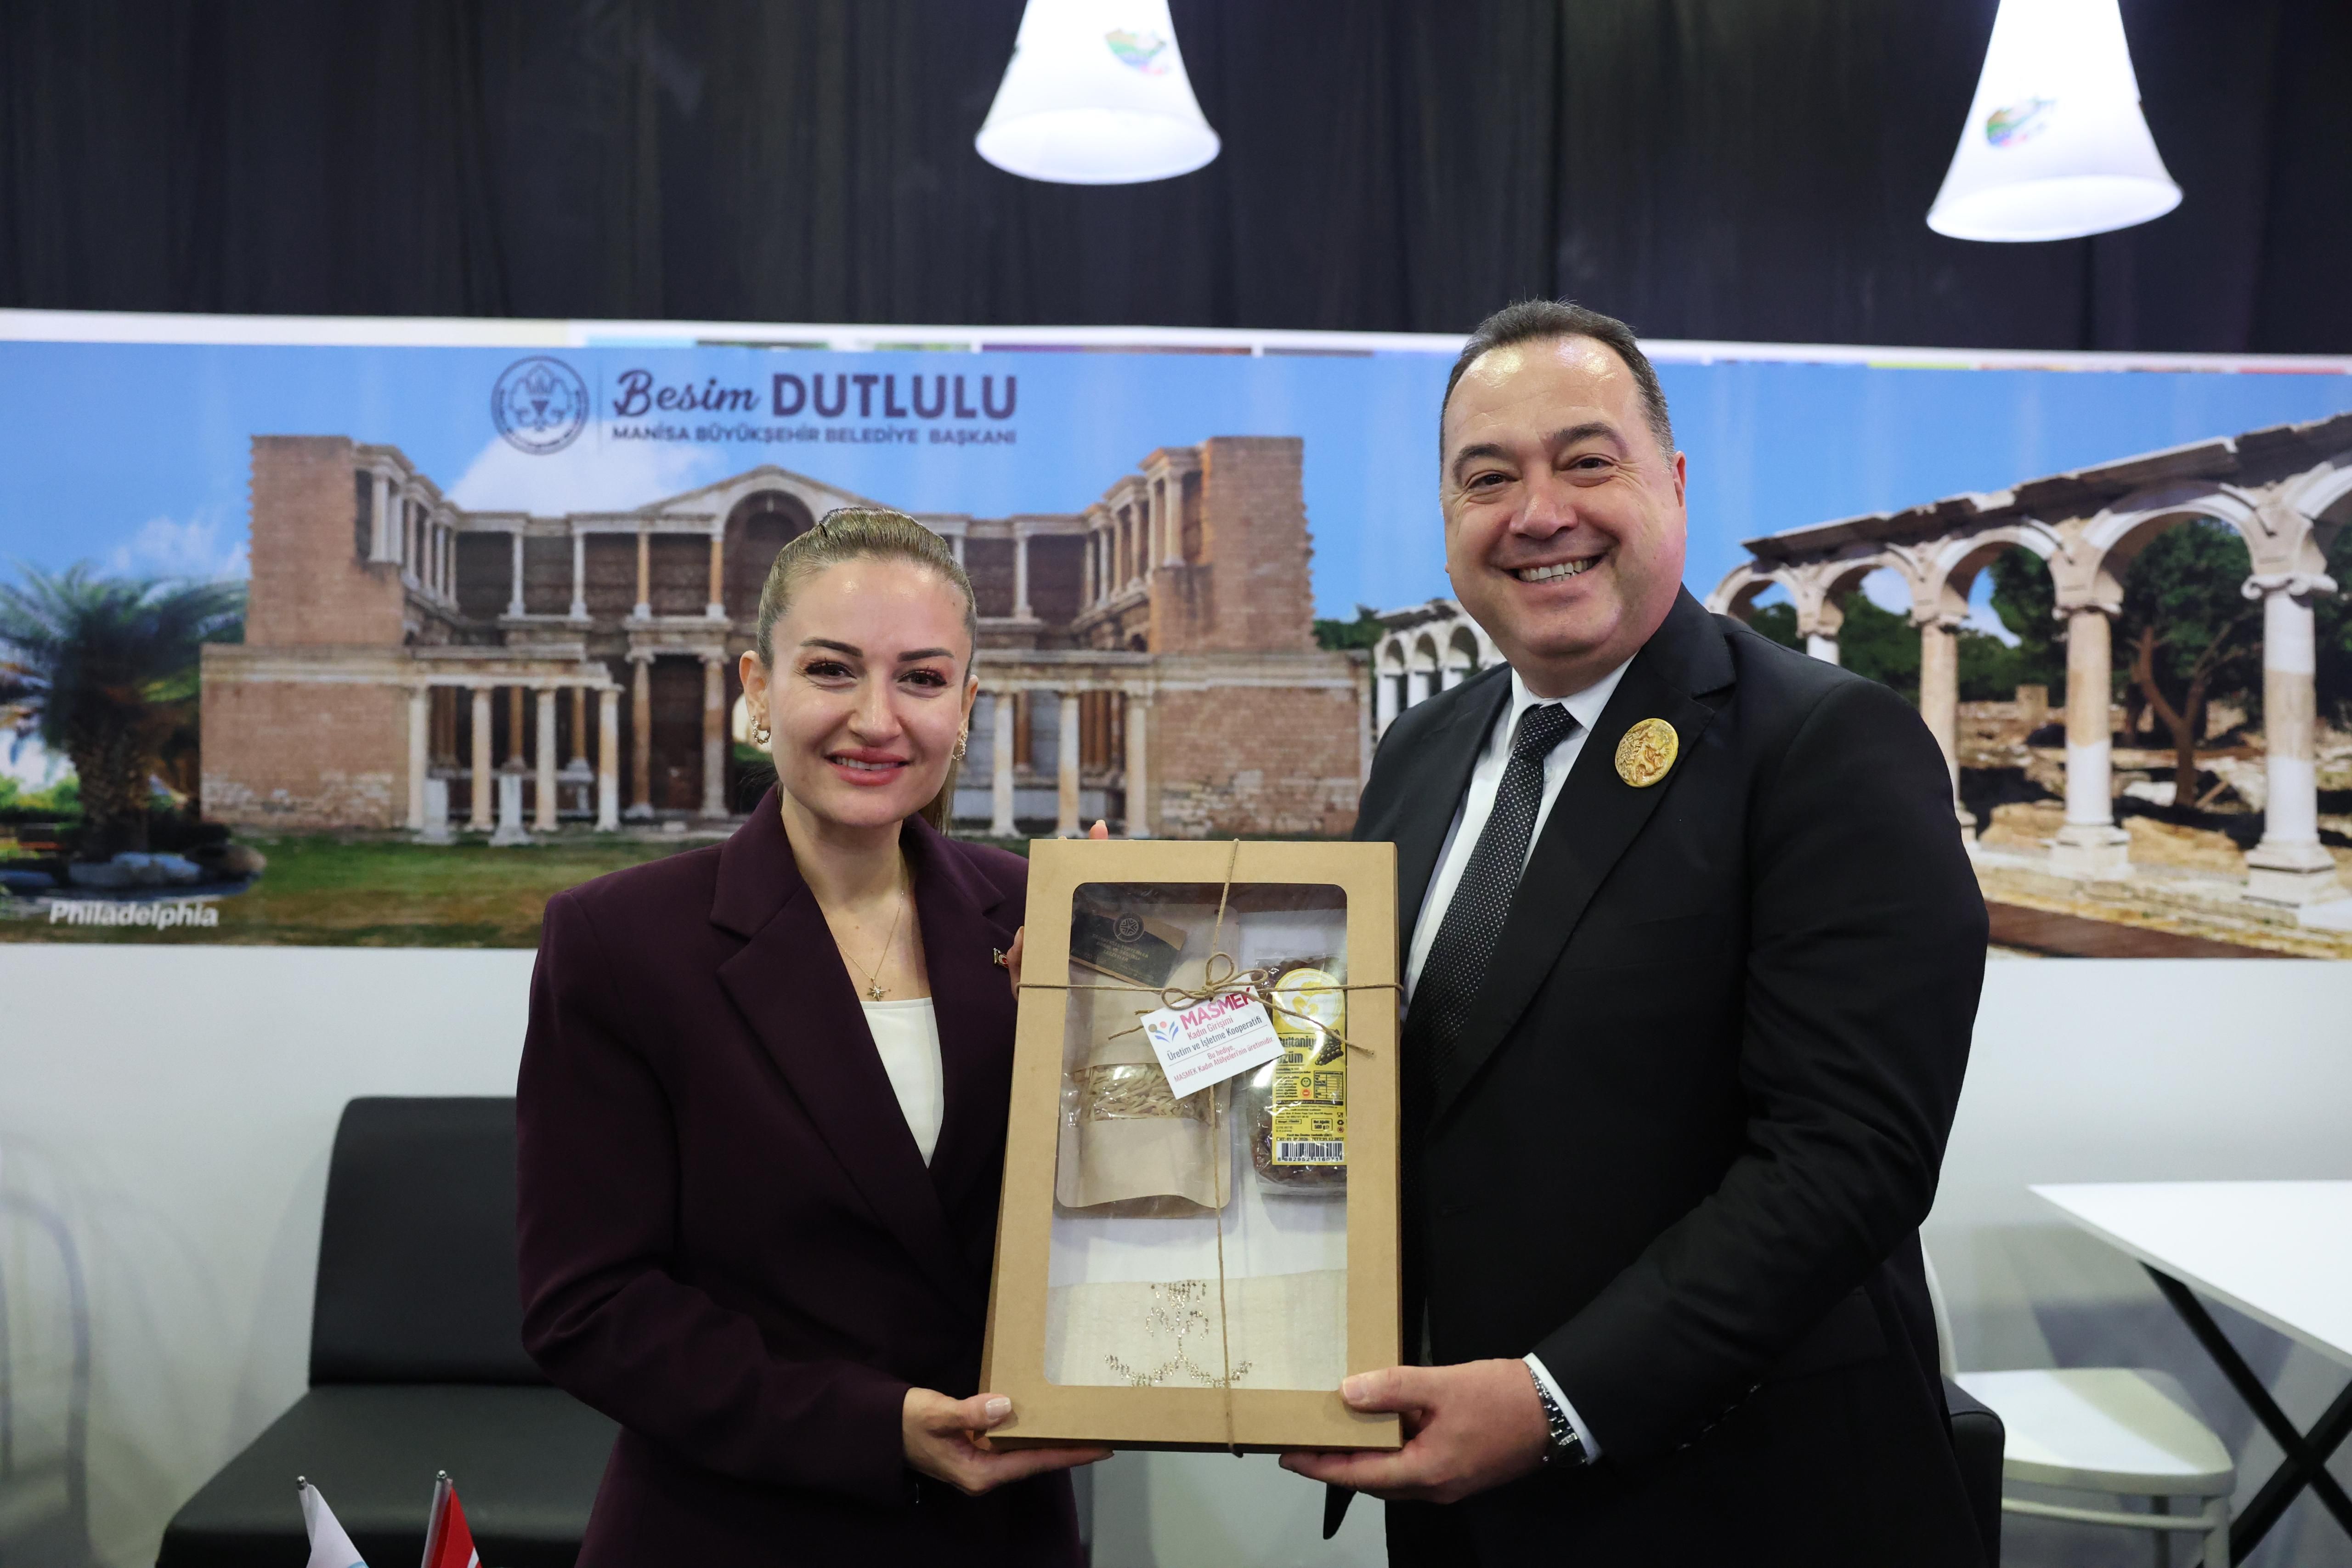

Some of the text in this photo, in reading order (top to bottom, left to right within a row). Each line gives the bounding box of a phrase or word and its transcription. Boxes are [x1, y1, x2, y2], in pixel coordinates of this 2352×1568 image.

[611, 369, 760, 417] Besim
[772, 373, 1017, 419] DUTLULU
[612, 422, 689, 441] MANİSA
[695, 422, 820, 444] BÜYÜKŞEHİR
[929, 428, 1017, 445] BAŞKANI
[49, 901, 219, 931] Philadelphia
[1180, 987, 1255, 1030] MASMEK
[1167, 1046, 1191, 1061] Üretim
[1199, 1033, 1226, 1047] İşletme
[1226, 1015, 1262, 1036] Kooperatifi
[1187, 1015, 1234, 1041] Kadın Girişimi
[1207, 1044, 1235, 1060] Bu hediye,
[1174, 1068, 1198, 1082] MASMEK
[1198, 1062, 1213, 1073] Kadın
